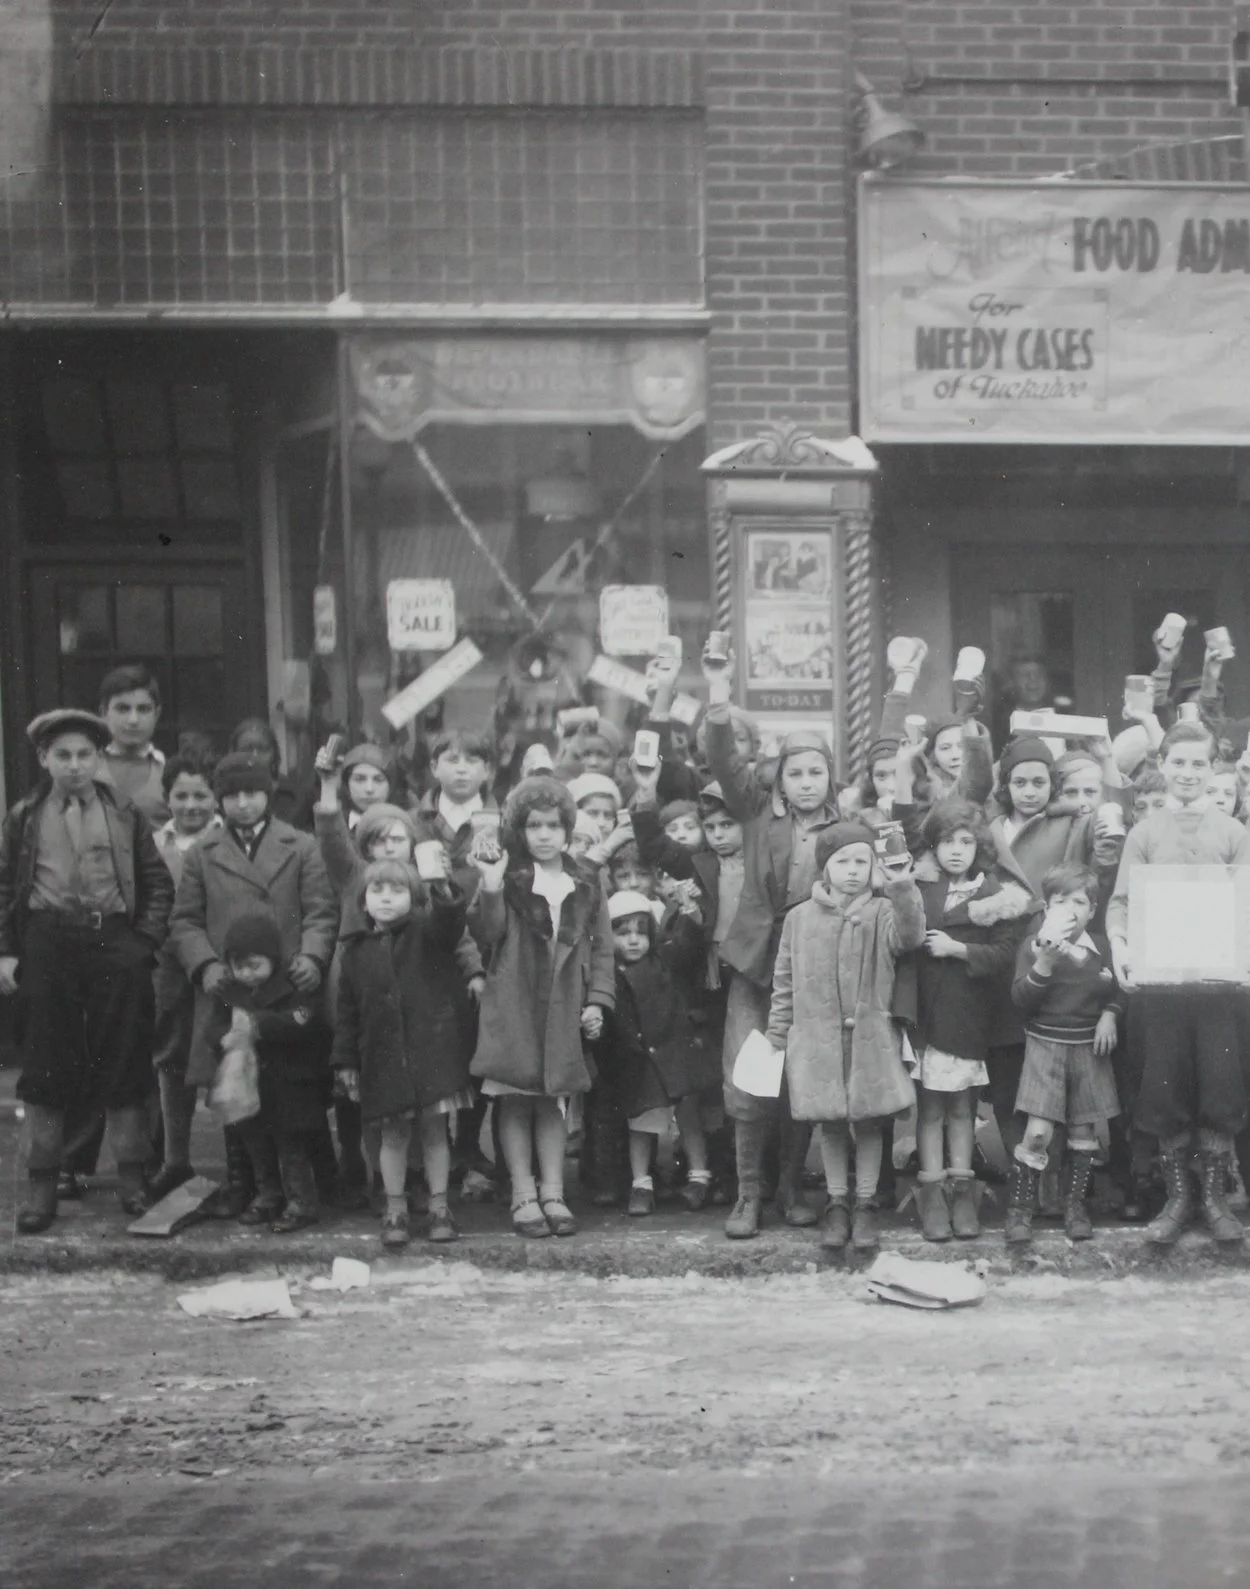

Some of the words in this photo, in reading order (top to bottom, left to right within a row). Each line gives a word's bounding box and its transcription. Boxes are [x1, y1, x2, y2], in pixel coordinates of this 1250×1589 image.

[1072, 216, 1160, 273] FOOD
[968, 292, 1025, 325] For
[915, 325, 1007, 371] NEEDY
[1016, 327, 1096, 371] CASES
[933, 375, 963, 399] of
[399, 615, 444, 632] SALE
